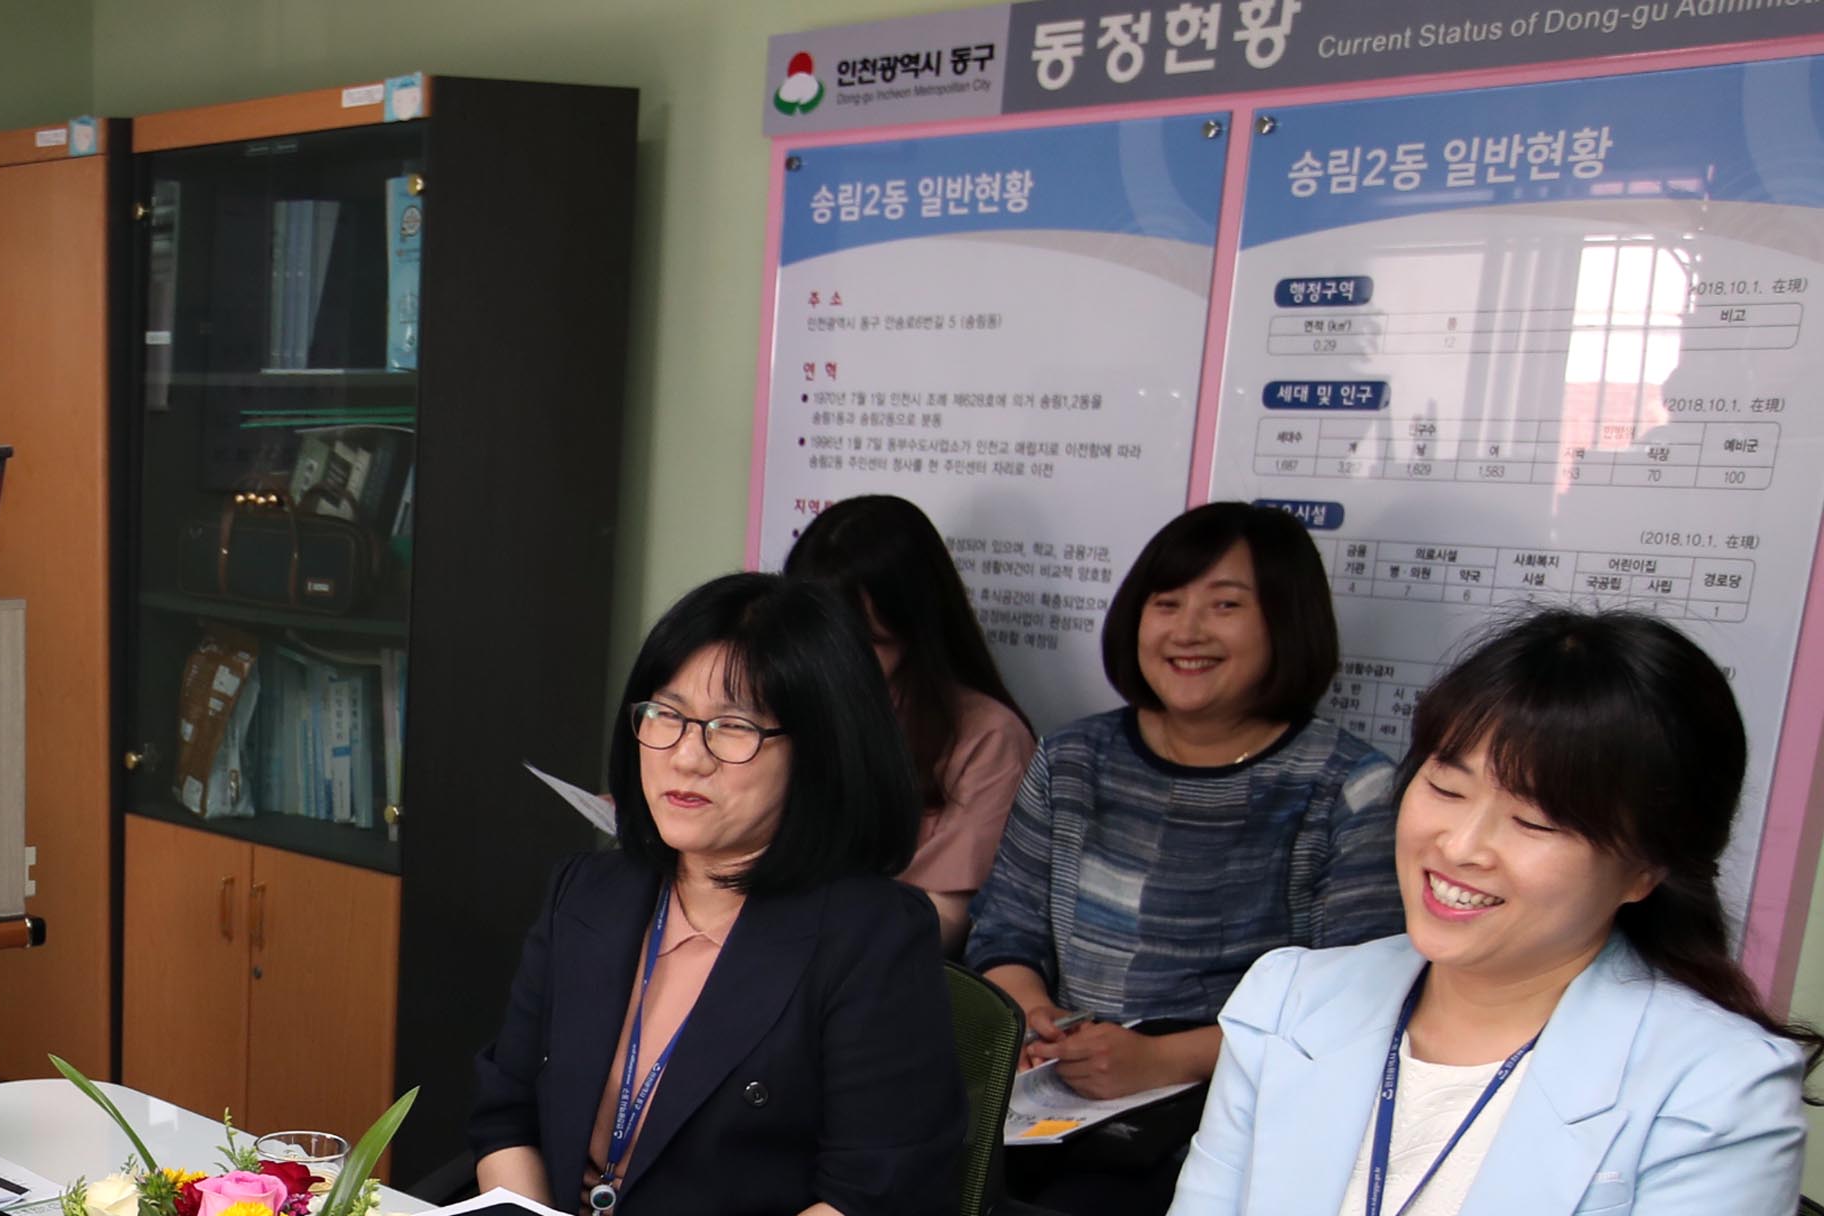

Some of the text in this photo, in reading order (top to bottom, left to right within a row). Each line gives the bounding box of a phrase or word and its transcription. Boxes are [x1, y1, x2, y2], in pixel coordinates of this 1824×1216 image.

[1318, 20, 1411, 59] Current
[1418, 20, 1503, 48] Status
[1511, 10, 1540, 37] of
[1544, 2, 1668, 33] Dong-gu
[1031, 0, 1301, 91] 동정현황
[836, 43, 995, 87] 인천광역시 동구
[877, 86, 911, 102] Incheon
[915, 81, 970, 99] Metropolitan
[973, 77, 991, 93] City
[1287, 126, 1614, 197] 송림2동 일반현황
[810, 169, 1035, 224] 송림2동 일반현황
[1289, 279, 1355, 302] 행정구역
[807, 315, 856, 332] 인천광역시
[861, 315, 880, 331] 동구
[949, 314, 956, 328] 5
[961, 313, 1002, 331] (송림동)
[1720, 309, 1746, 322] 비고
[890, 392, 921, 407] 인천시
[1277, 384, 1373, 406] 세대 및 인구
[1724, 438, 1759, 454] 예비군
[1648, 469, 1661, 482] 70
[1725, 471, 1745, 484] 100
[1640, 530, 1718, 547] (2018.10.1.
[1415, 547, 1459, 563] 의료시설
[1513, 552, 1560, 569] 사회복지
[1608, 558, 1657, 574] 어린이집
[1703, 572, 1742, 589] 경로당
